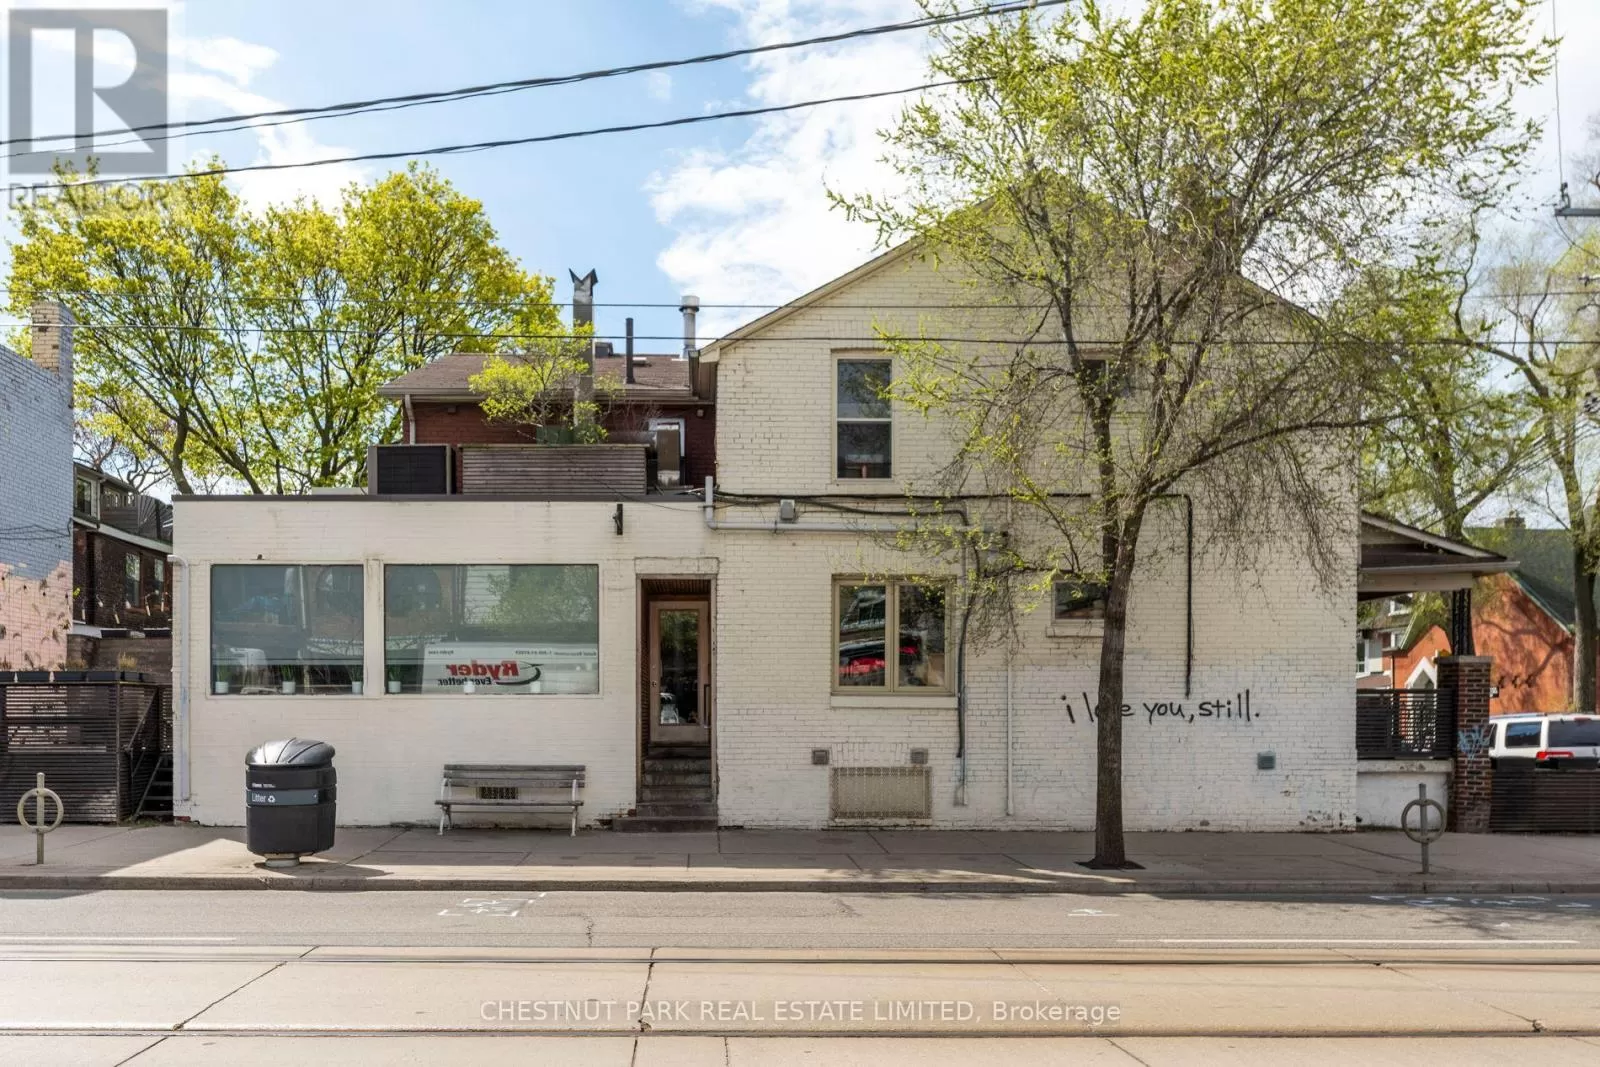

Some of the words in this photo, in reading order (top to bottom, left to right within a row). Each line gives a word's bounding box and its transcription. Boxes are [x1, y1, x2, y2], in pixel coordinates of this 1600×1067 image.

[1060, 695, 1075, 724] i
[1082, 692, 1135, 722] le
[252, 792, 266, 802] Litter
